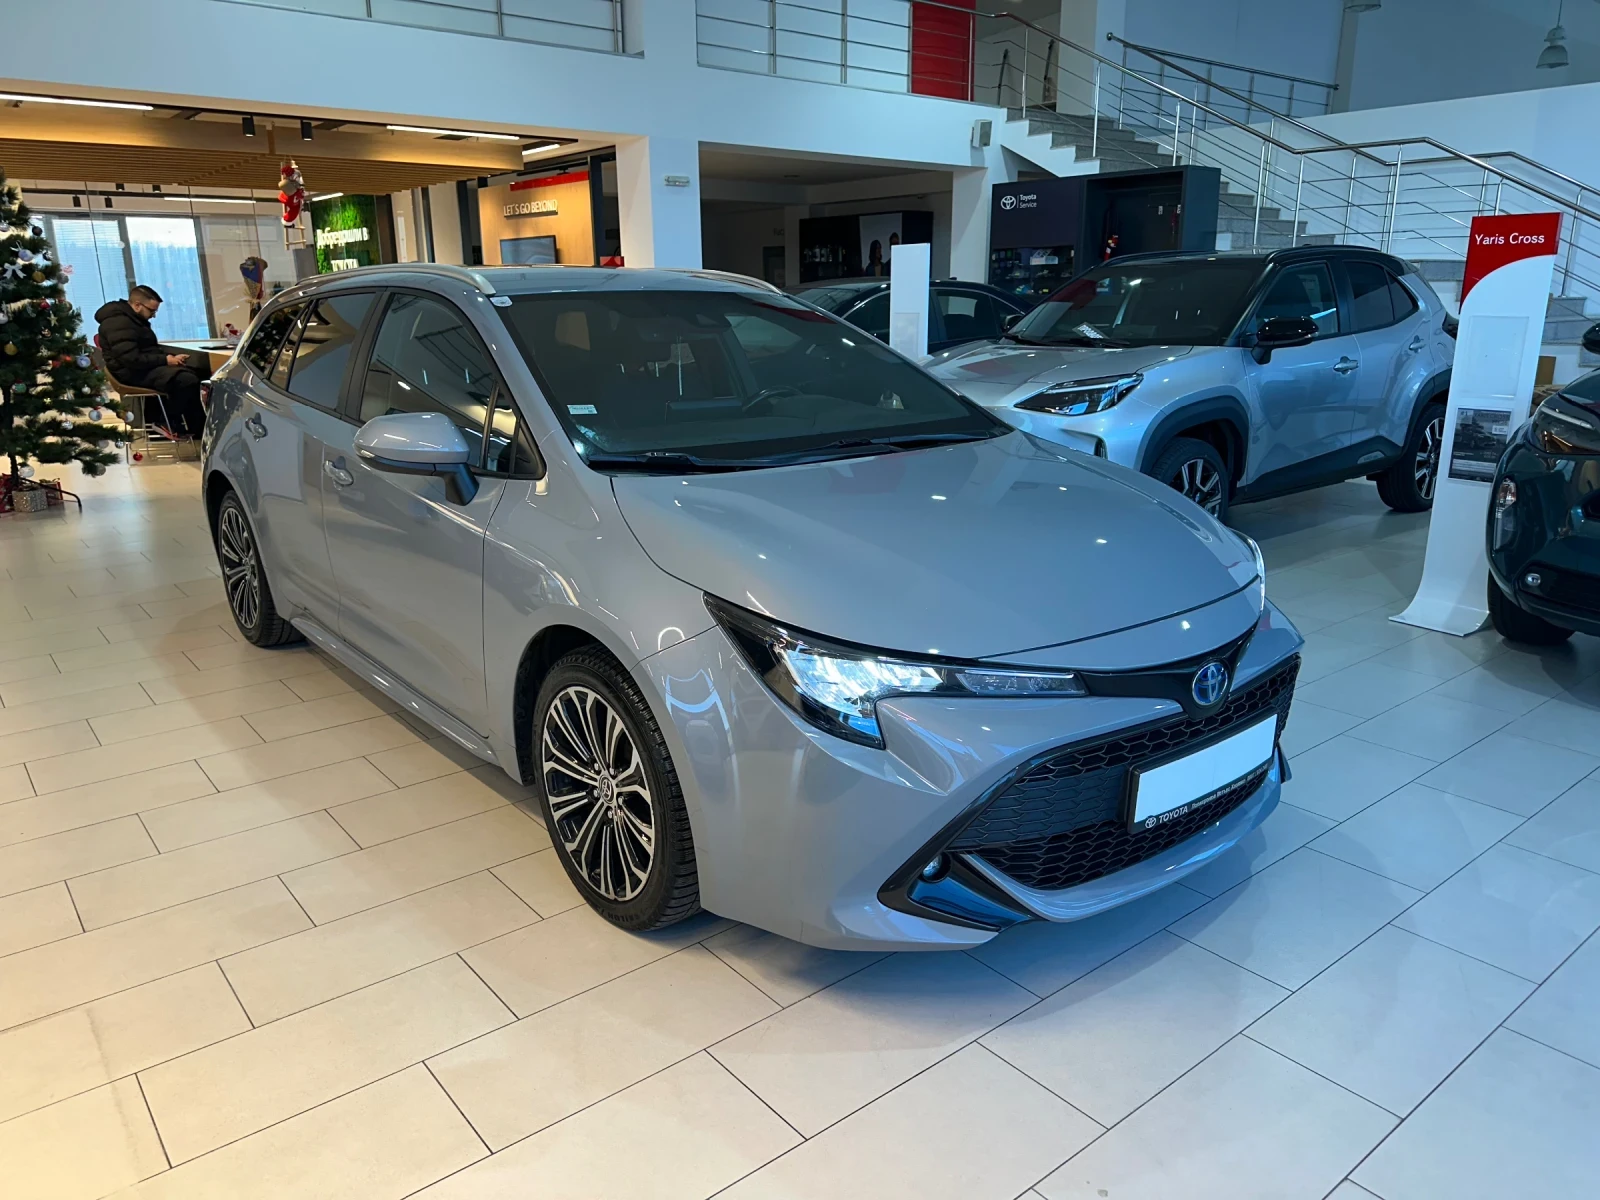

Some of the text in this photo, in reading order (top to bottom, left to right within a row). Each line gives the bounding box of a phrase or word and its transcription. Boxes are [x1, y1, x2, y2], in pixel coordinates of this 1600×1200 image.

[519, 202, 531, 214] GO
[531, 199, 558, 213] BEYOND
[1475, 232, 1545, 245] Yaris Cross
[331, 259, 359, 272] TOYOTA
[1159, 806, 1188, 823] TOYOTA
